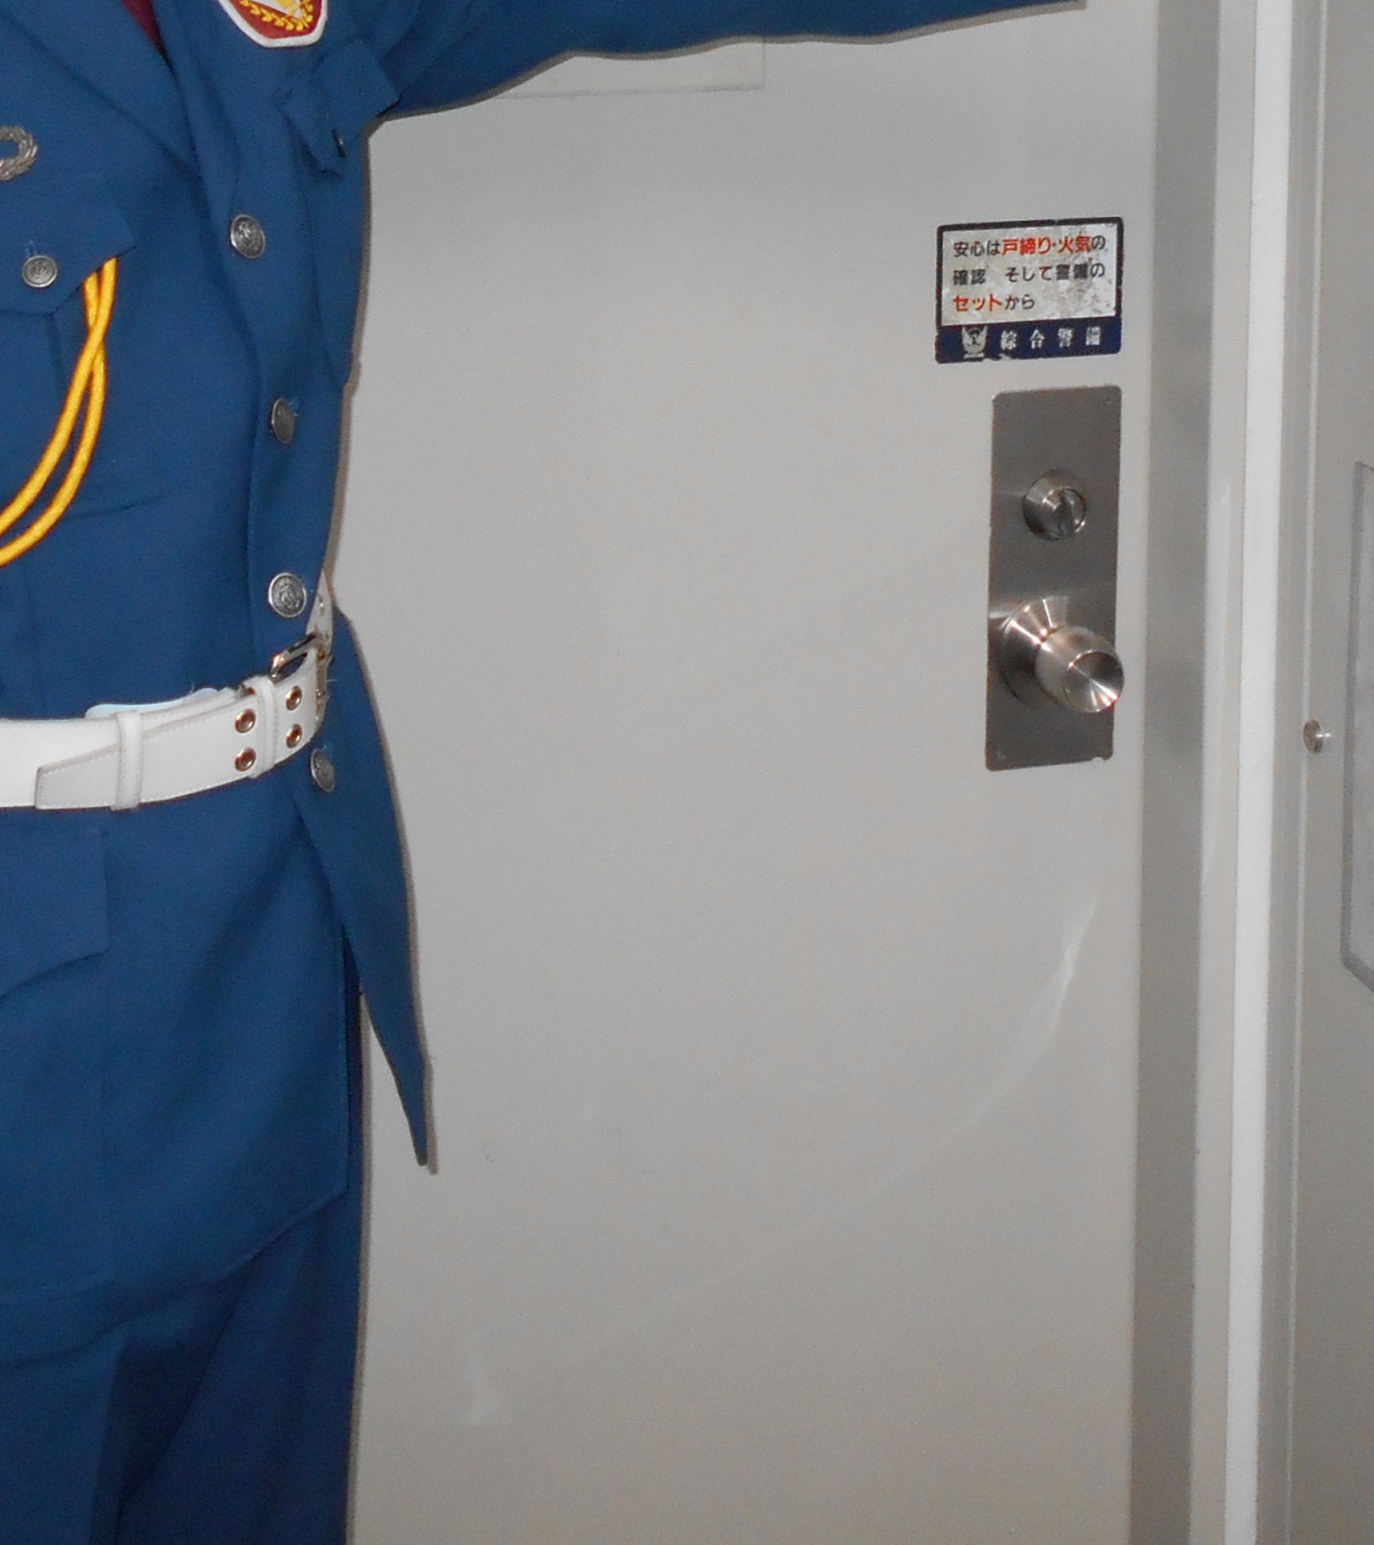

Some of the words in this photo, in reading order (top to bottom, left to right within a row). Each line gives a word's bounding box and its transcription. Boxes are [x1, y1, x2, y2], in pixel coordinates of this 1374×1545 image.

[953, 235, 1106, 257] 安心は戸締り・火気の
[953, 269, 986, 286] 確認
[953, 294, 1035, 312] セットから
